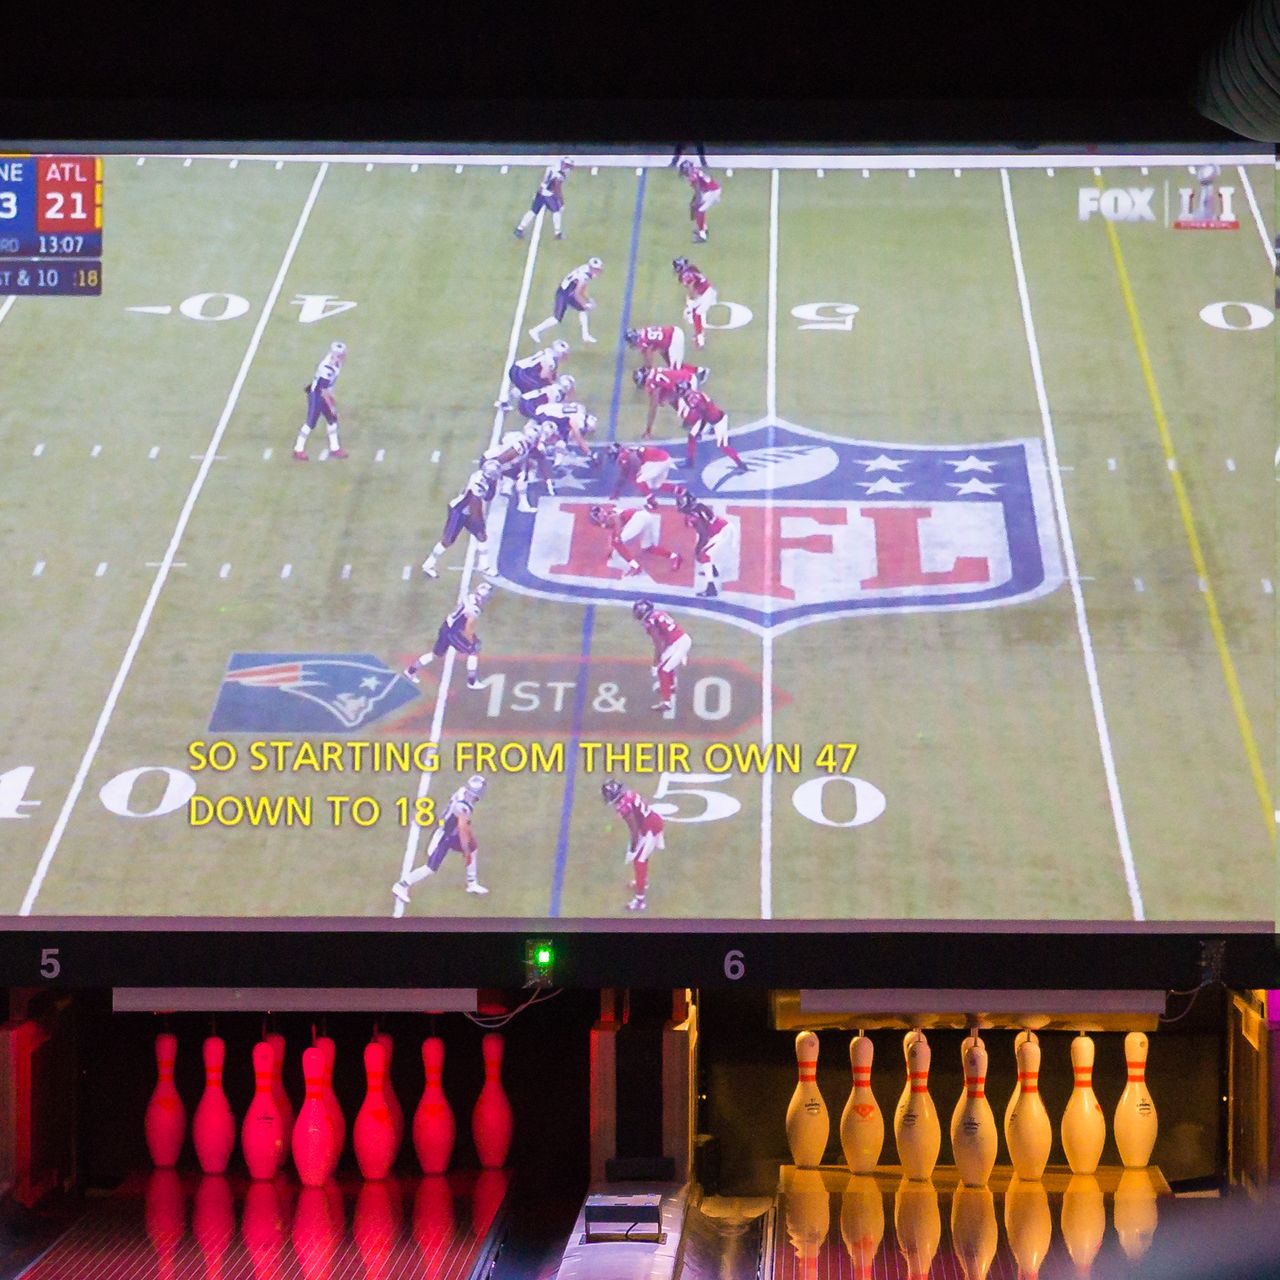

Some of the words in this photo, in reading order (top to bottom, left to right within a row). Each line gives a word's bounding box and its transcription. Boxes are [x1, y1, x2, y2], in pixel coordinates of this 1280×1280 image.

[45, 163, 88, 182] ATL
[45, 192, 88, 220] 21
[1078, 187, 1156, 222] FOX
[38, 236, 84, 253] 13:07
[17, 269, 30, 287] &
[37, 269, 59, 287] 10
[483, 673, 576, 717] 1ST
[592, 681, 626, 713] &
[189, 741, 237, 771] SO
[249, 741, 440, 772] STARTING
[456, 742, 564, 773] FROM
[579, 743, 692, 773] THEIR
[705, 743, 801, 773] OWN
[816, 743, 858, 773] 47
[190, 796, 311, 826] DOWN
[327, 796, 380, 826] TO
[396, 797, 445, 826] 18.
[41, 948, 60, 979] 5
[724, 950, 745, 980] 6
